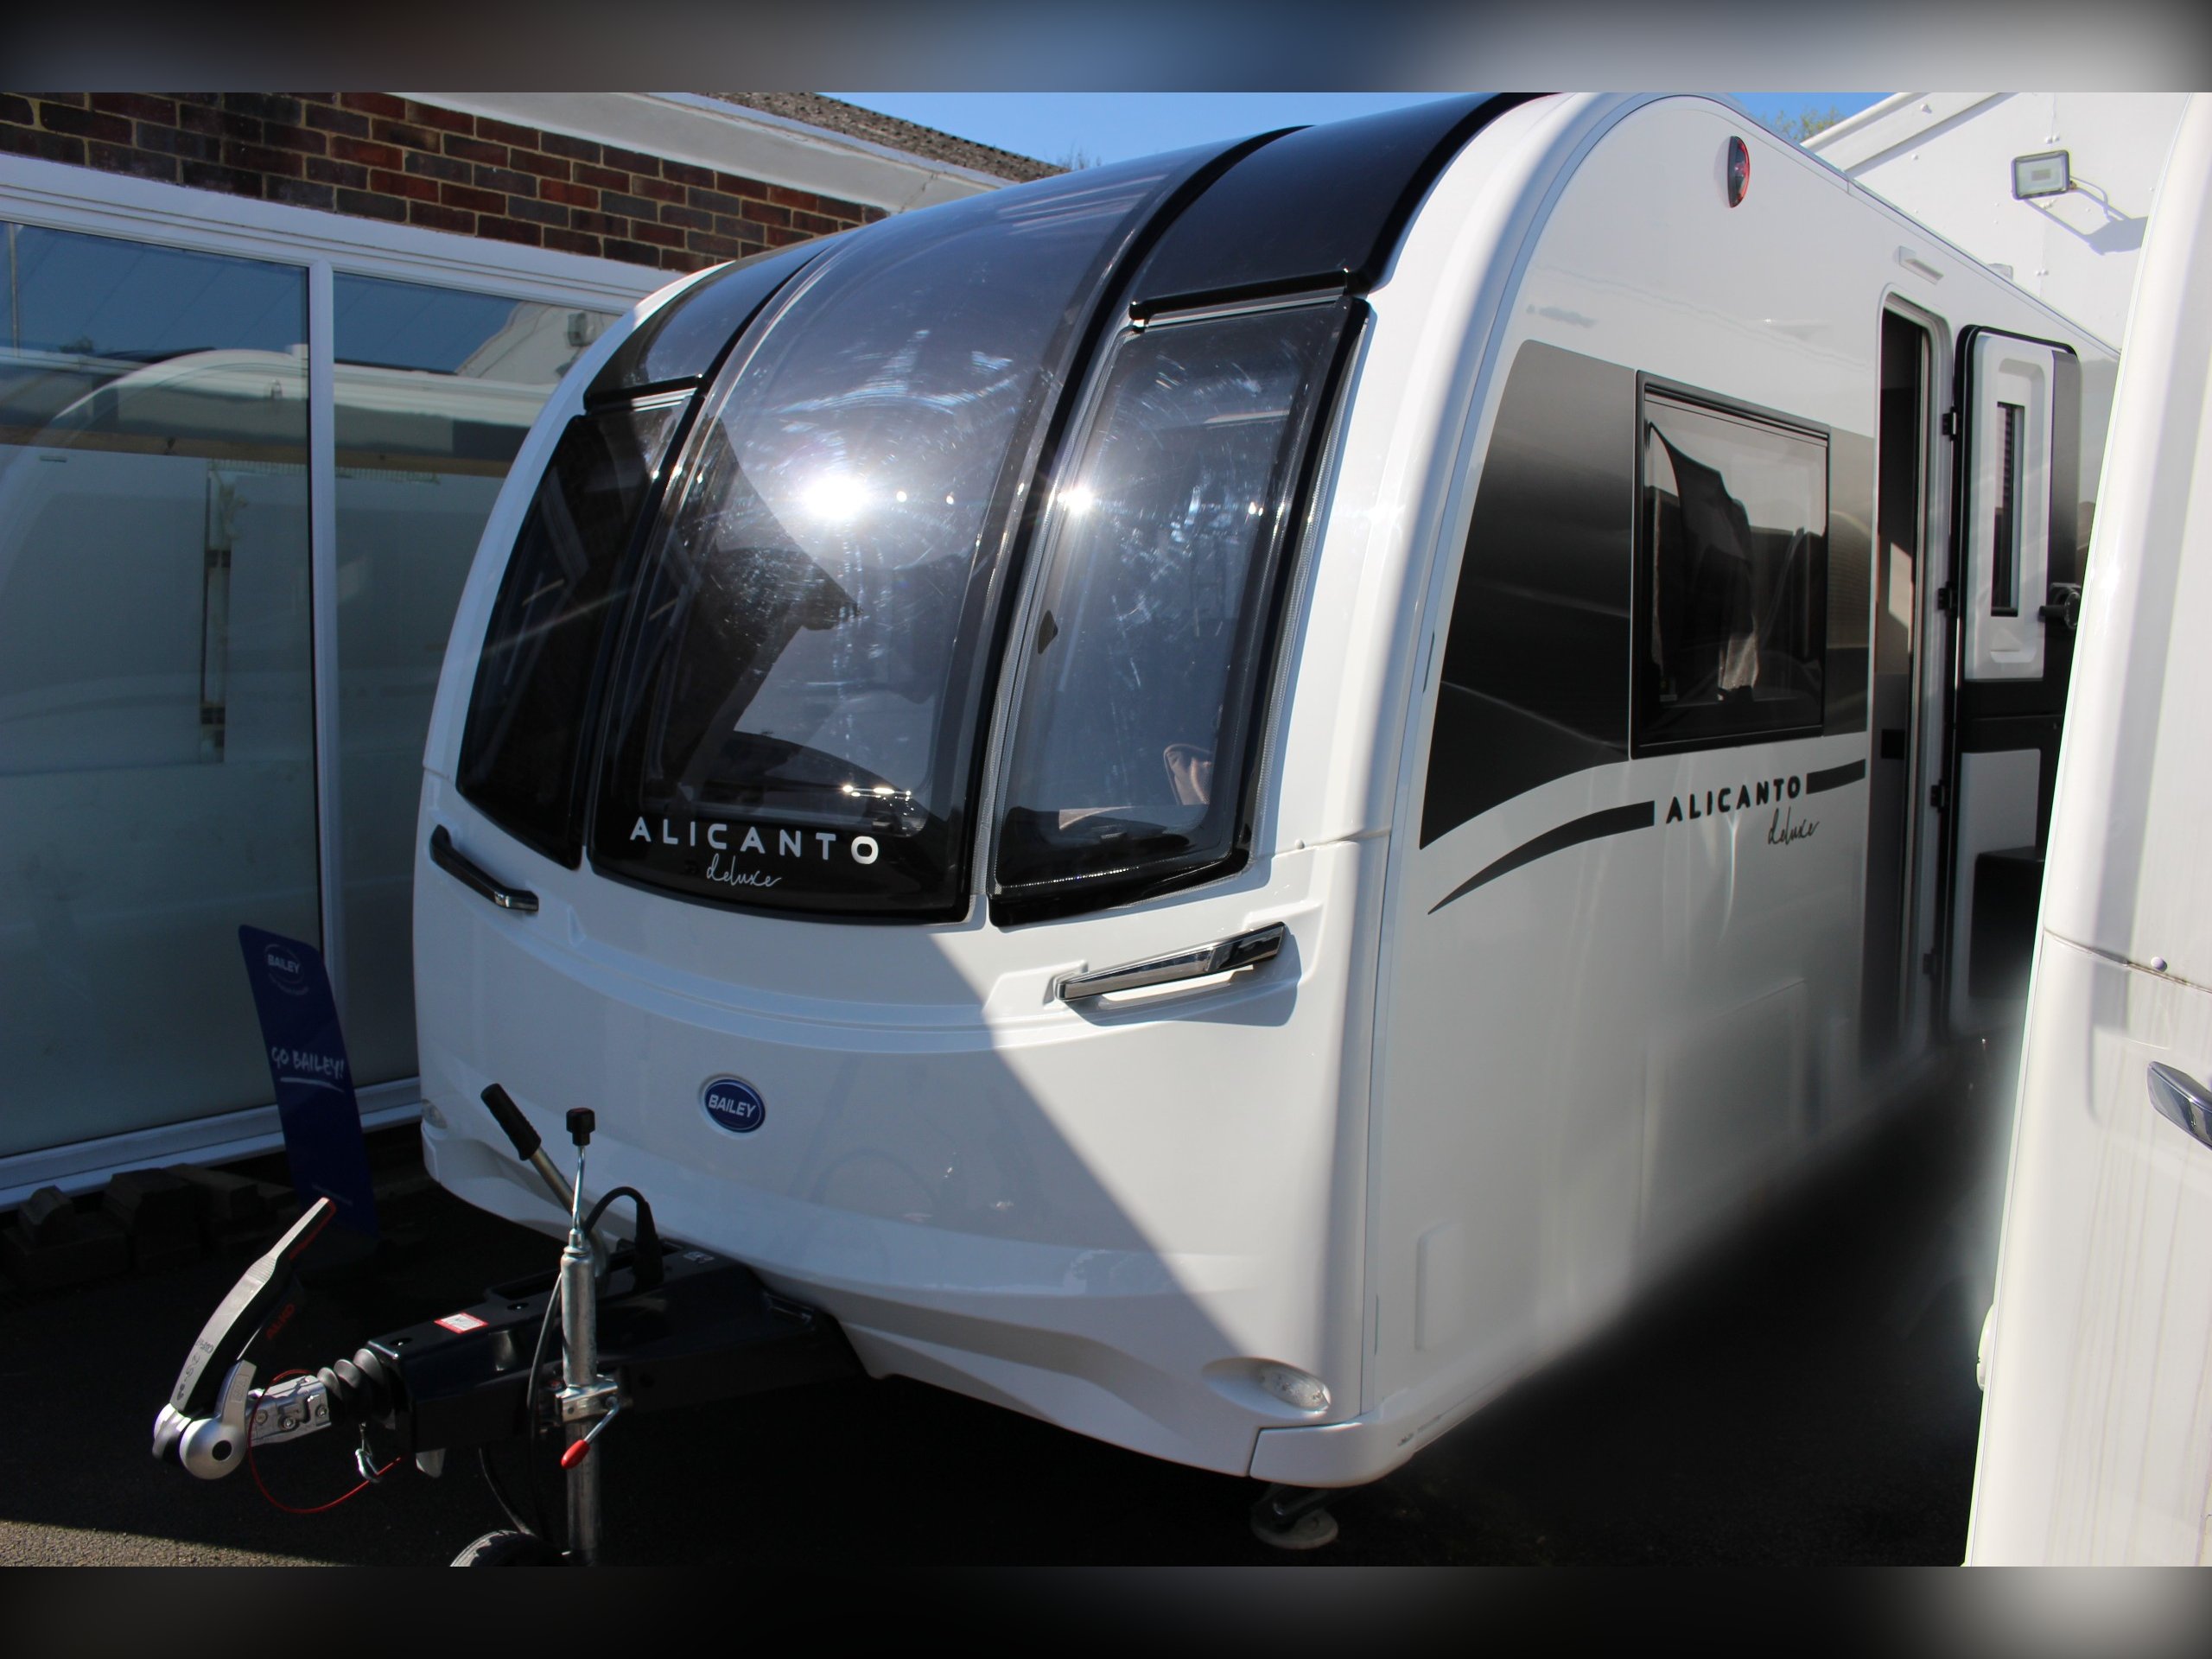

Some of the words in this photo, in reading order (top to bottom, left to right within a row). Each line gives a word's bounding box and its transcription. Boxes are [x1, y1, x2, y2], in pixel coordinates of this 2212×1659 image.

[1666, 775, 1802, 823] ALICANTO
[630, 817, 879, 865] ALICANTO
[1768, 805, 1820, 845] deluxe
[706, 853, 782, 887] deluxe
[267, 953, 301, 974] BAILEY
[271, 1046, 289, 1069] GO
[292, 1050, 346, 1079] BAILEY!
[709, 1093, 757, 1118] BAILEY
